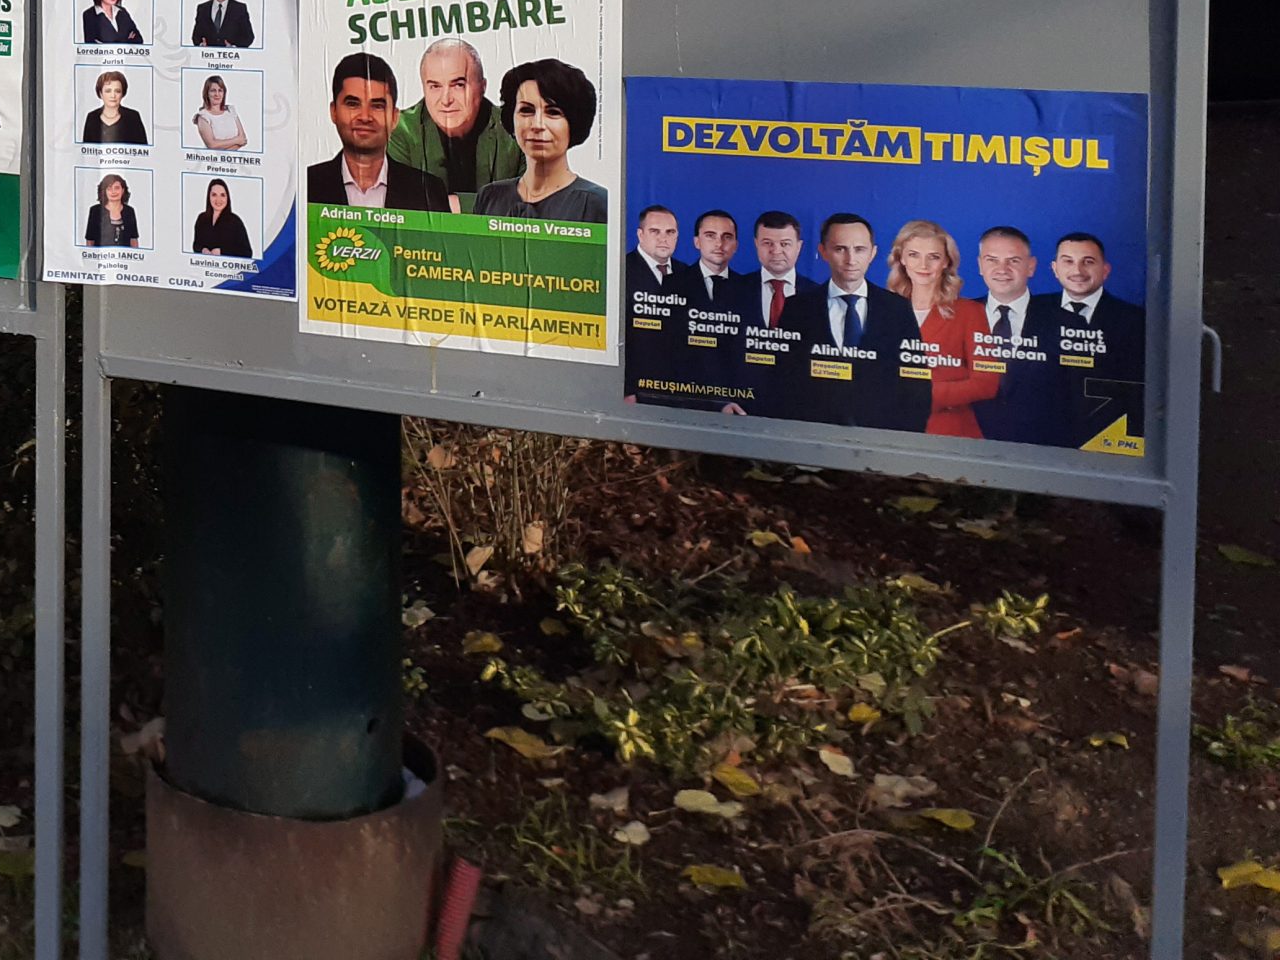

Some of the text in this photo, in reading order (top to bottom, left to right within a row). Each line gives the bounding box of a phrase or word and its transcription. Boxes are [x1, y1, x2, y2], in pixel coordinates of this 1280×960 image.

[202, 51, 240, 60] Ion TECA
[667, 119, 1110, 177] DEZVOLTĂM TIMIȘUL
[320, 206, 405, 224] Adrian Todea
[488, 219, 592, 238] Simona Vrazsa
[332, 244, 381, 261] VERZII
[393, 245, 442, 262] Pentru
[47, 270, 204, 288] DEMNITATE ONOARE CURAJ
[633, 291, 687, 306] Claudiu
[313, 296, 600, 338] VOTEAZĂ VERDE ÎN PARLAMENT!
[633, 304, 671, 317] Chira
[688, 308, 741, 323] Cosmin
[746, 326, 801, 341] Marilen
[974, 332, 1038, 348] Ben-Oni
[746, 339, 790, 352] Pirtea
[811, 344, 877, 360] Alin Nica
[900, 339, 940, 353] Alina
[973, 346, 1047, 361] Ardelean
[899, 352, 962, 368] Gorghiu
